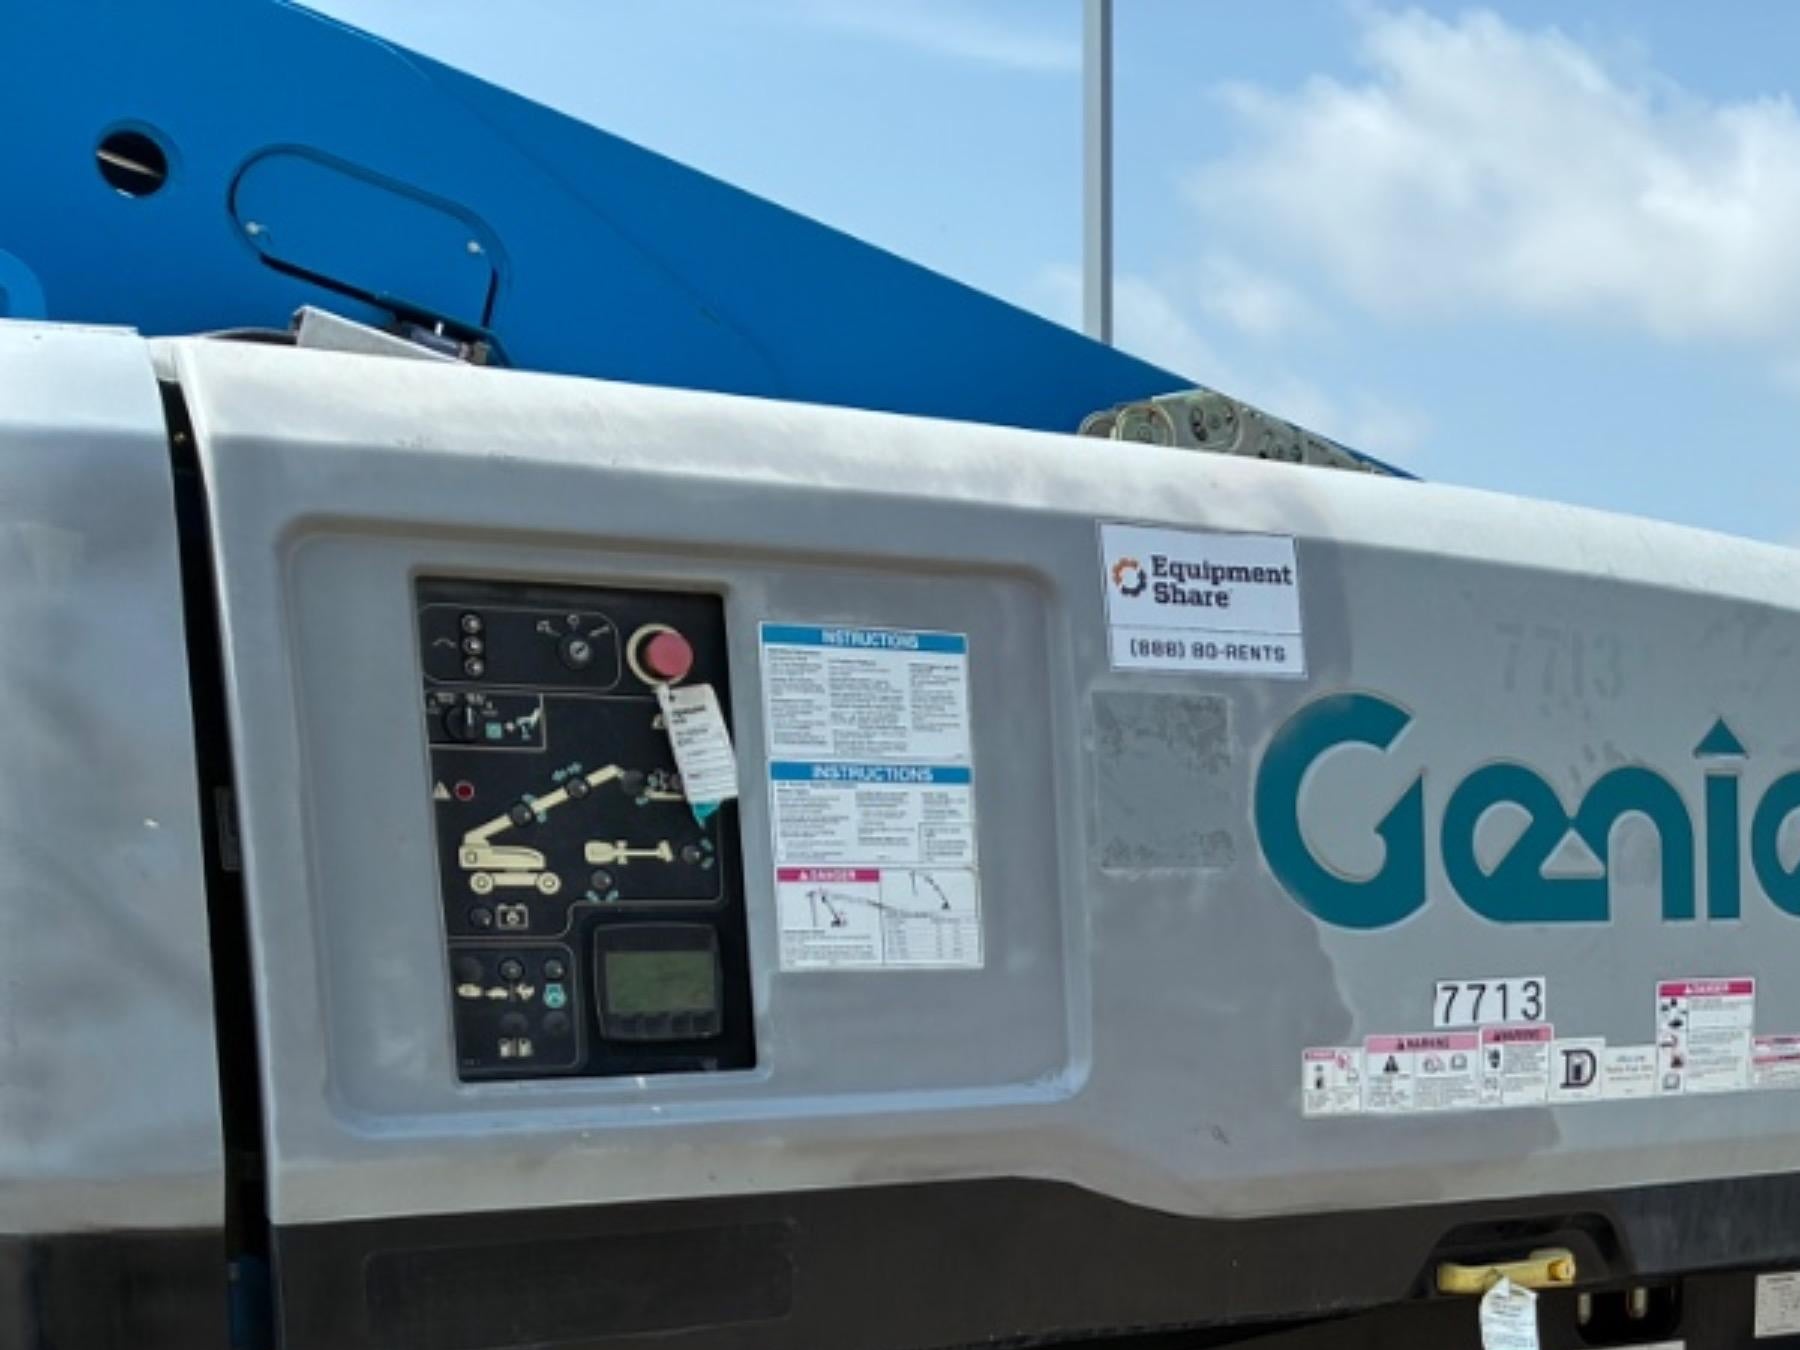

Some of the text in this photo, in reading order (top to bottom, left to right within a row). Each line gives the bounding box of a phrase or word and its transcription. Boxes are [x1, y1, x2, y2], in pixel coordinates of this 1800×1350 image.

[1150, 554, 1294, 587] Equipment
[1153, 582, 1231, 608] Share
[821, 629, 919, 649] INSTRUCTIONS
[1130, 638, 1287, 662] (888) 80-RENTS
[811, 764, 934, 782] INSTRUCTIONS
[1441, 980, 1542, 1024] 7713
